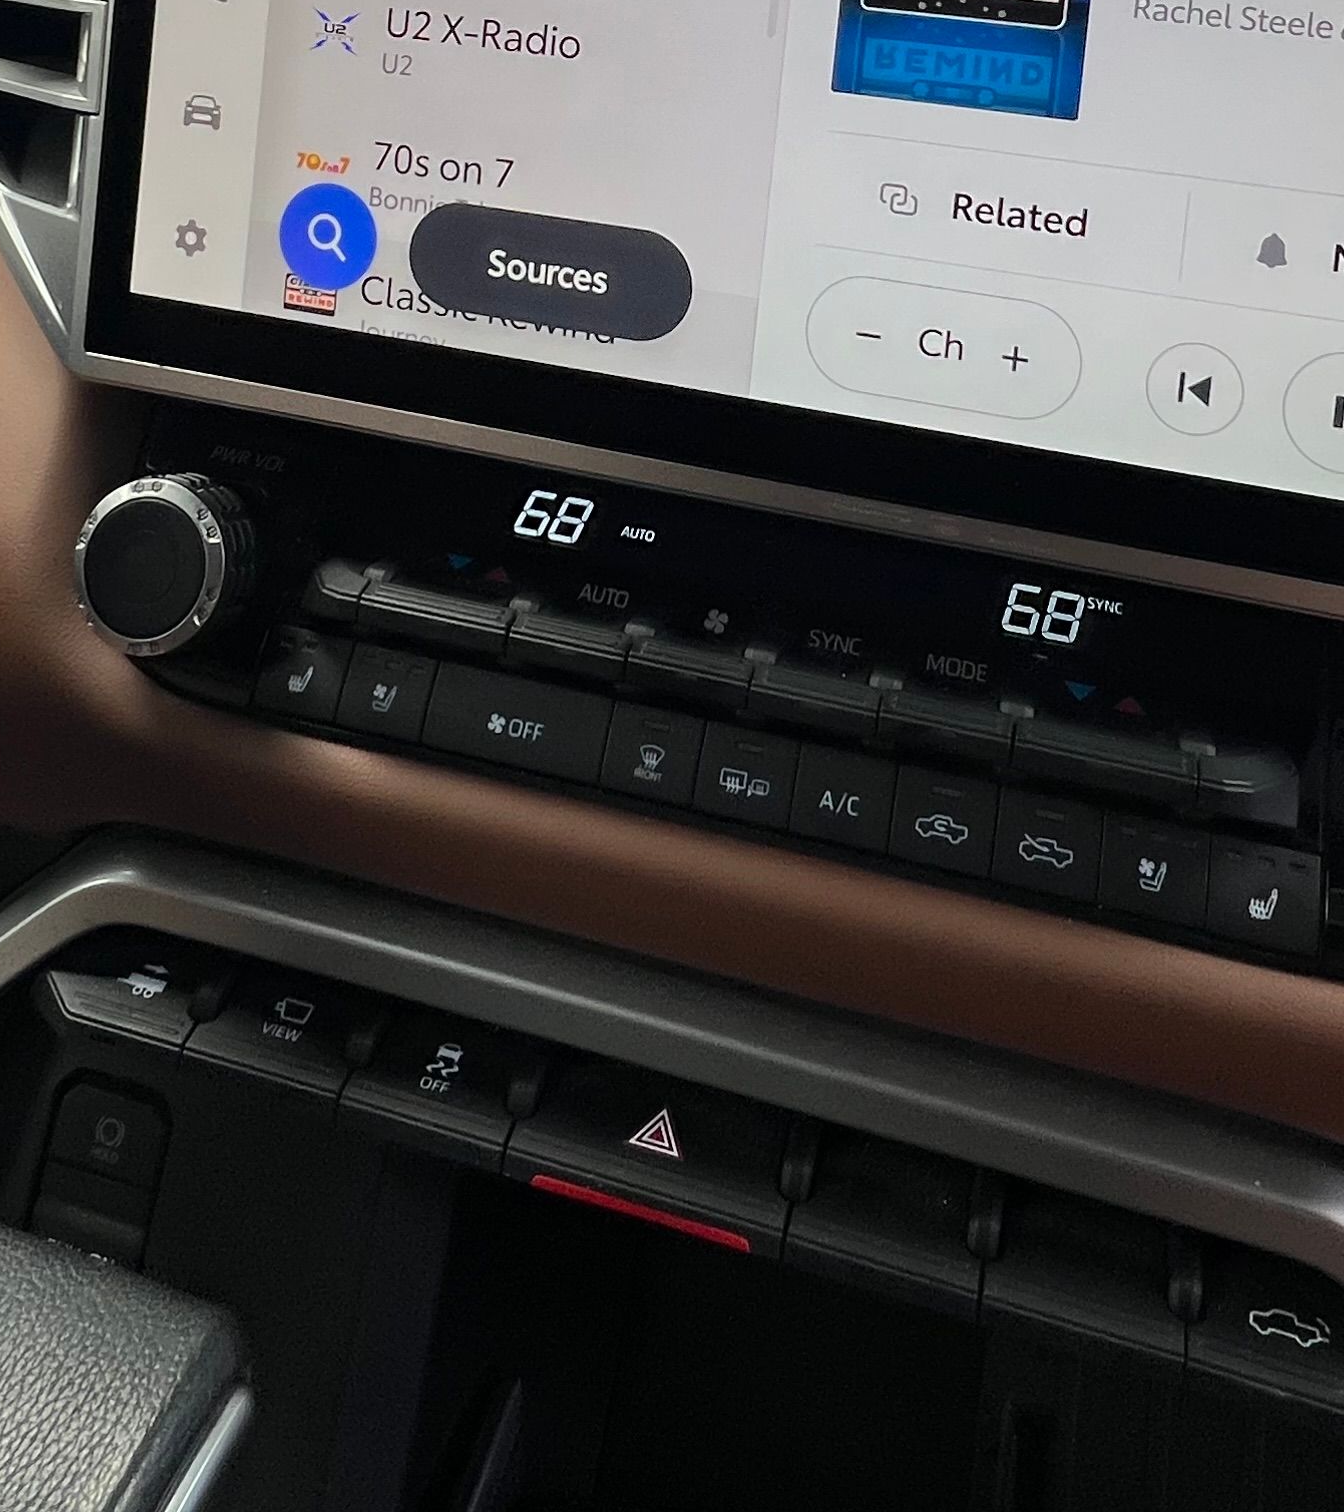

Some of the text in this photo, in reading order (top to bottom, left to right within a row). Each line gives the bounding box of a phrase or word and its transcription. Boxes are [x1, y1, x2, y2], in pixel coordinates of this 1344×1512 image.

[324, 23, 346, 36] U2
[387, 8, 581, 60] U2 X-Radio
[1241, 4, 1334, 39] Steele
[381, 52, 413, 77] U2
[374, 142, 515, 188] 70s on 7
[952, 193, 1088, 239] Related
[487, 248, 609, 295] Sources
[287, 293, 334, 308] REWIND
[918, 329, 965, 362] Ch
[209, 444, 253, 465] PWR
[513, 489, 656, 545] 68 AUTO
[577, 583, 630, 609] AUTO
[1001, 583, 1124, 645] 68 SYNC
[808, 629, 861, 656] SYNC
[925, 653, 988, 683] MODE
[507, 717, 544, 742] OFF
[819, 789, 860, 818] A/C
[262, 1021, 303, 1042] VIEW
[419, 1076, 451, 1094] OFF
